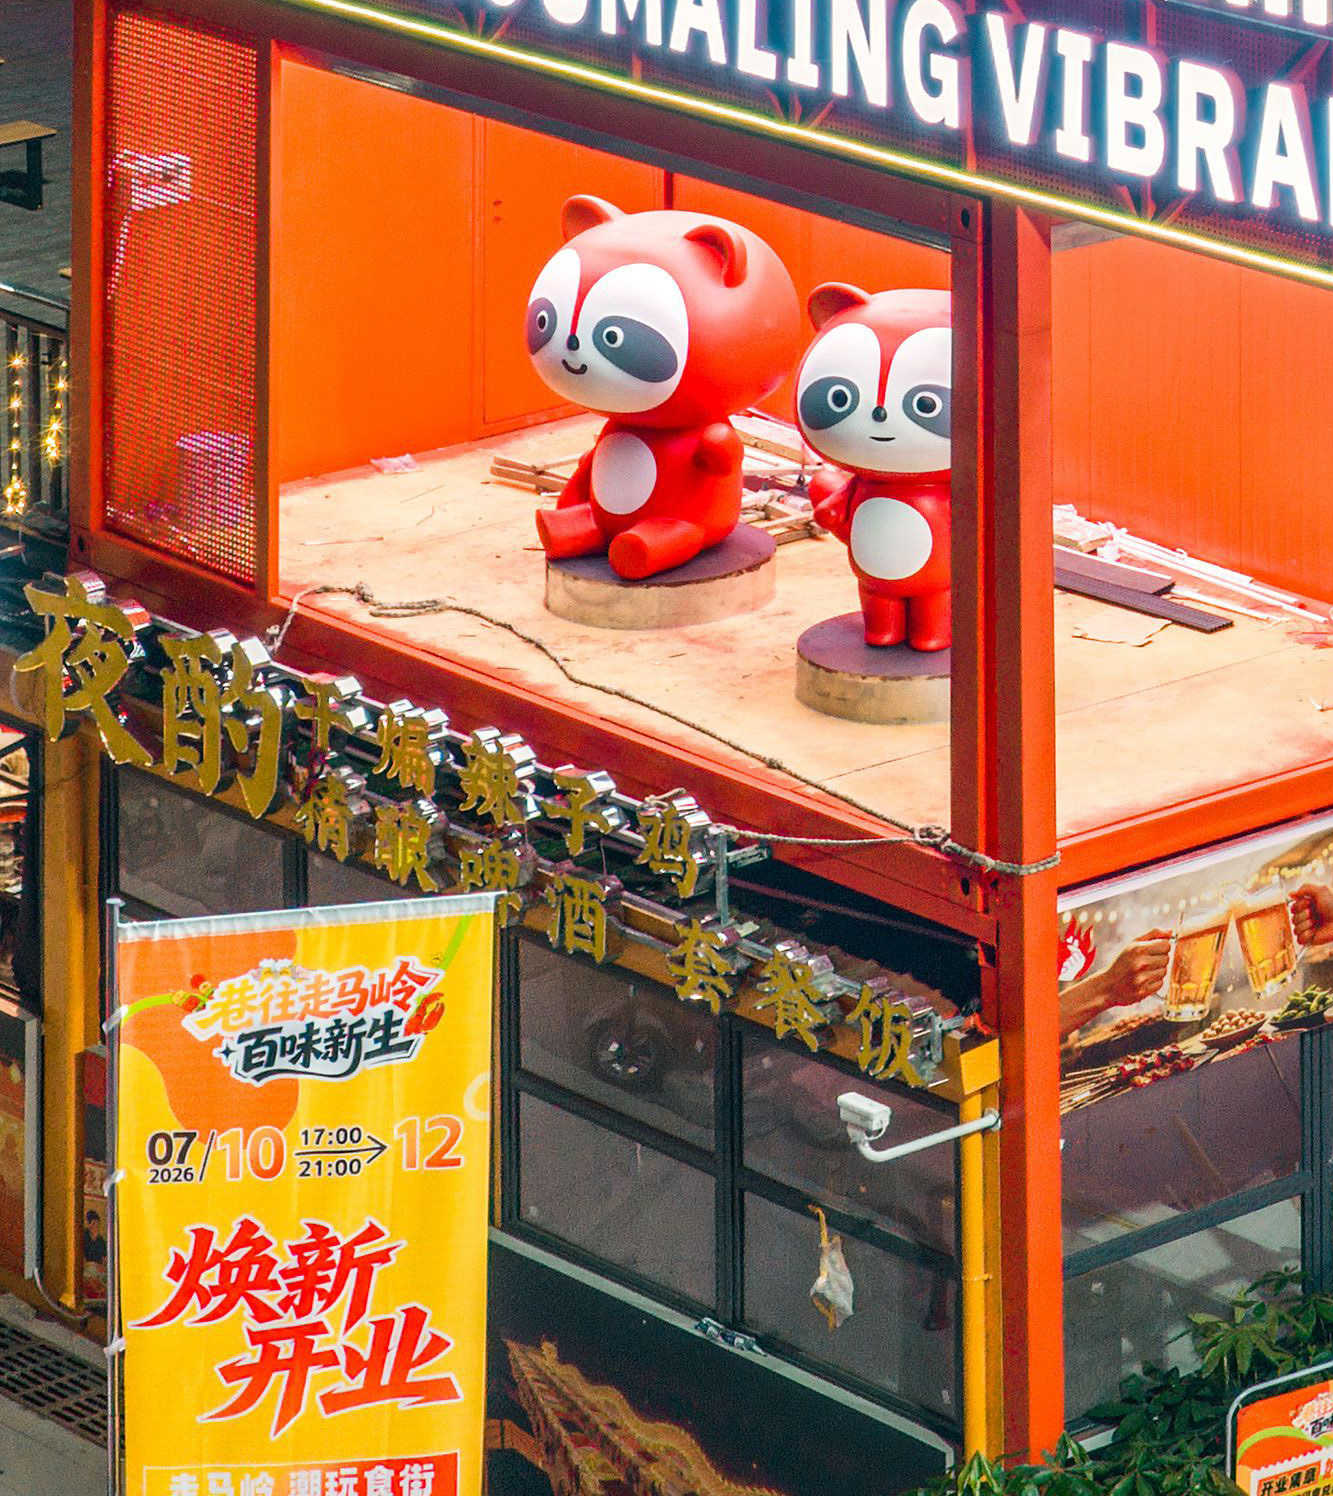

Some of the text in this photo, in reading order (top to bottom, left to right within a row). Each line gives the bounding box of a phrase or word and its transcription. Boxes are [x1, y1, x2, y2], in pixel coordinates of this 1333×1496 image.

[13, 575, 282, 819] 夜酌
[295, 678, 698, 898] 干煸辣子鸡
[296, 788, 607, 964] 精酿啤酒
[200, 960, 434, 1032] 巷往走马岭
[666, 918, 924, 1088] 套餐饭
[235, 1009, 414, 1079] 百味新生
[148, 1166, 195, 1184] 2026
[298, 1157, 362, 1178] 21:00
[300, 1127, 362, 1146] 17:00
[393, 1115, 463, 1171] 12
[130, 1215, 405, 1330] 焕新
[198, 1307, 462, 1439] 开业
